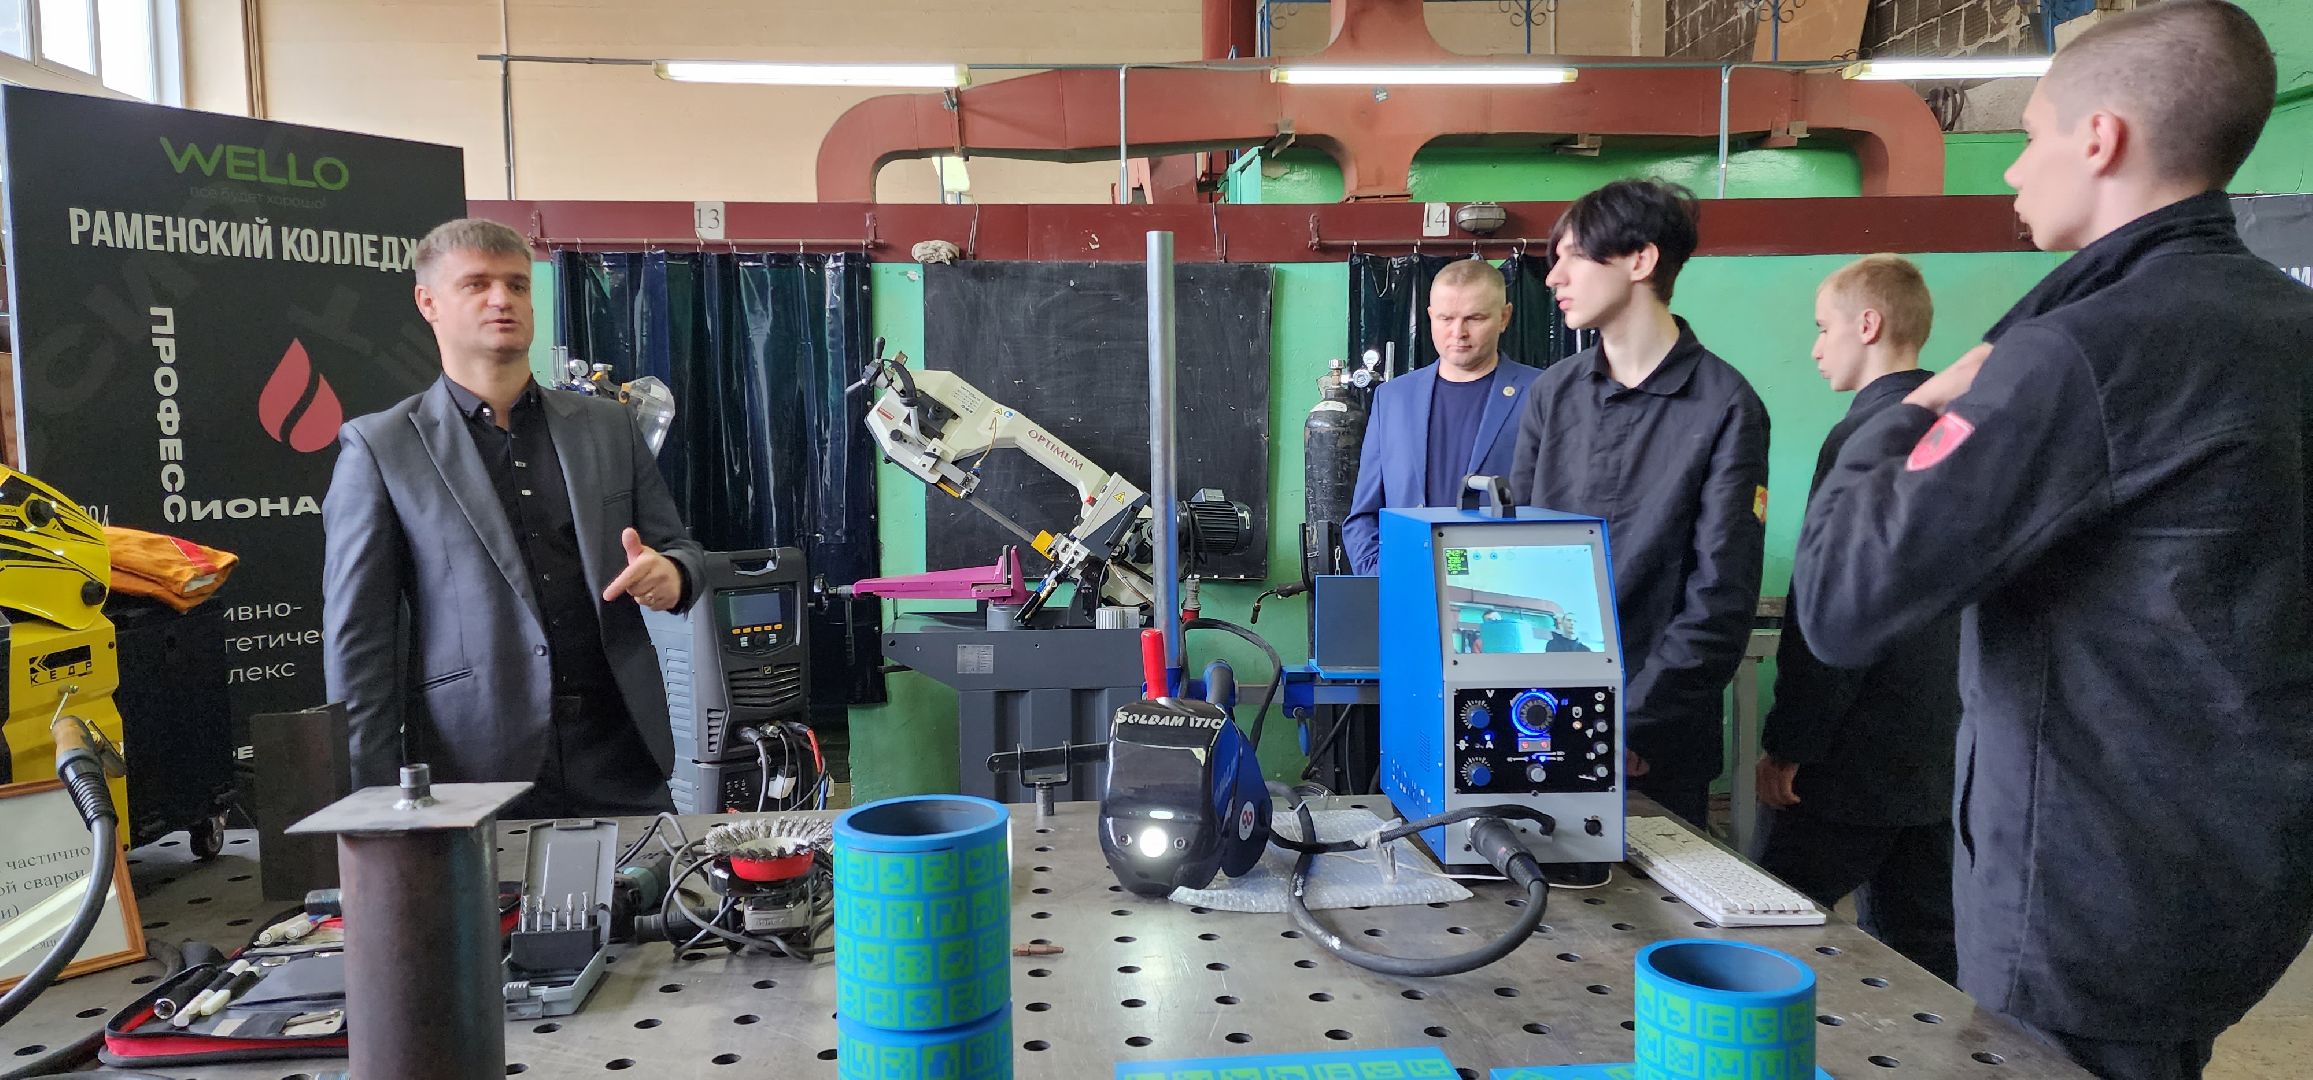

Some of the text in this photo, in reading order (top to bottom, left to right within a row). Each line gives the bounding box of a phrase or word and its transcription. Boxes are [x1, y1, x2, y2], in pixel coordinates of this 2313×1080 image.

[159, 136, 349, 191] WELLO
[696, 208, 720, 229] 13
[1426, 204, 1448, 228] 14
[68, 207, 273, 260] РАМЕНСКИЙ
[1028, 429, 1084, 471] OPTIMUM
[225, 629, 325, 653] гетиче
[30, 660, 92, 685] КЕДР
[6, 846, 91, 870] частично
[23, 869, 86, 889] сварки
